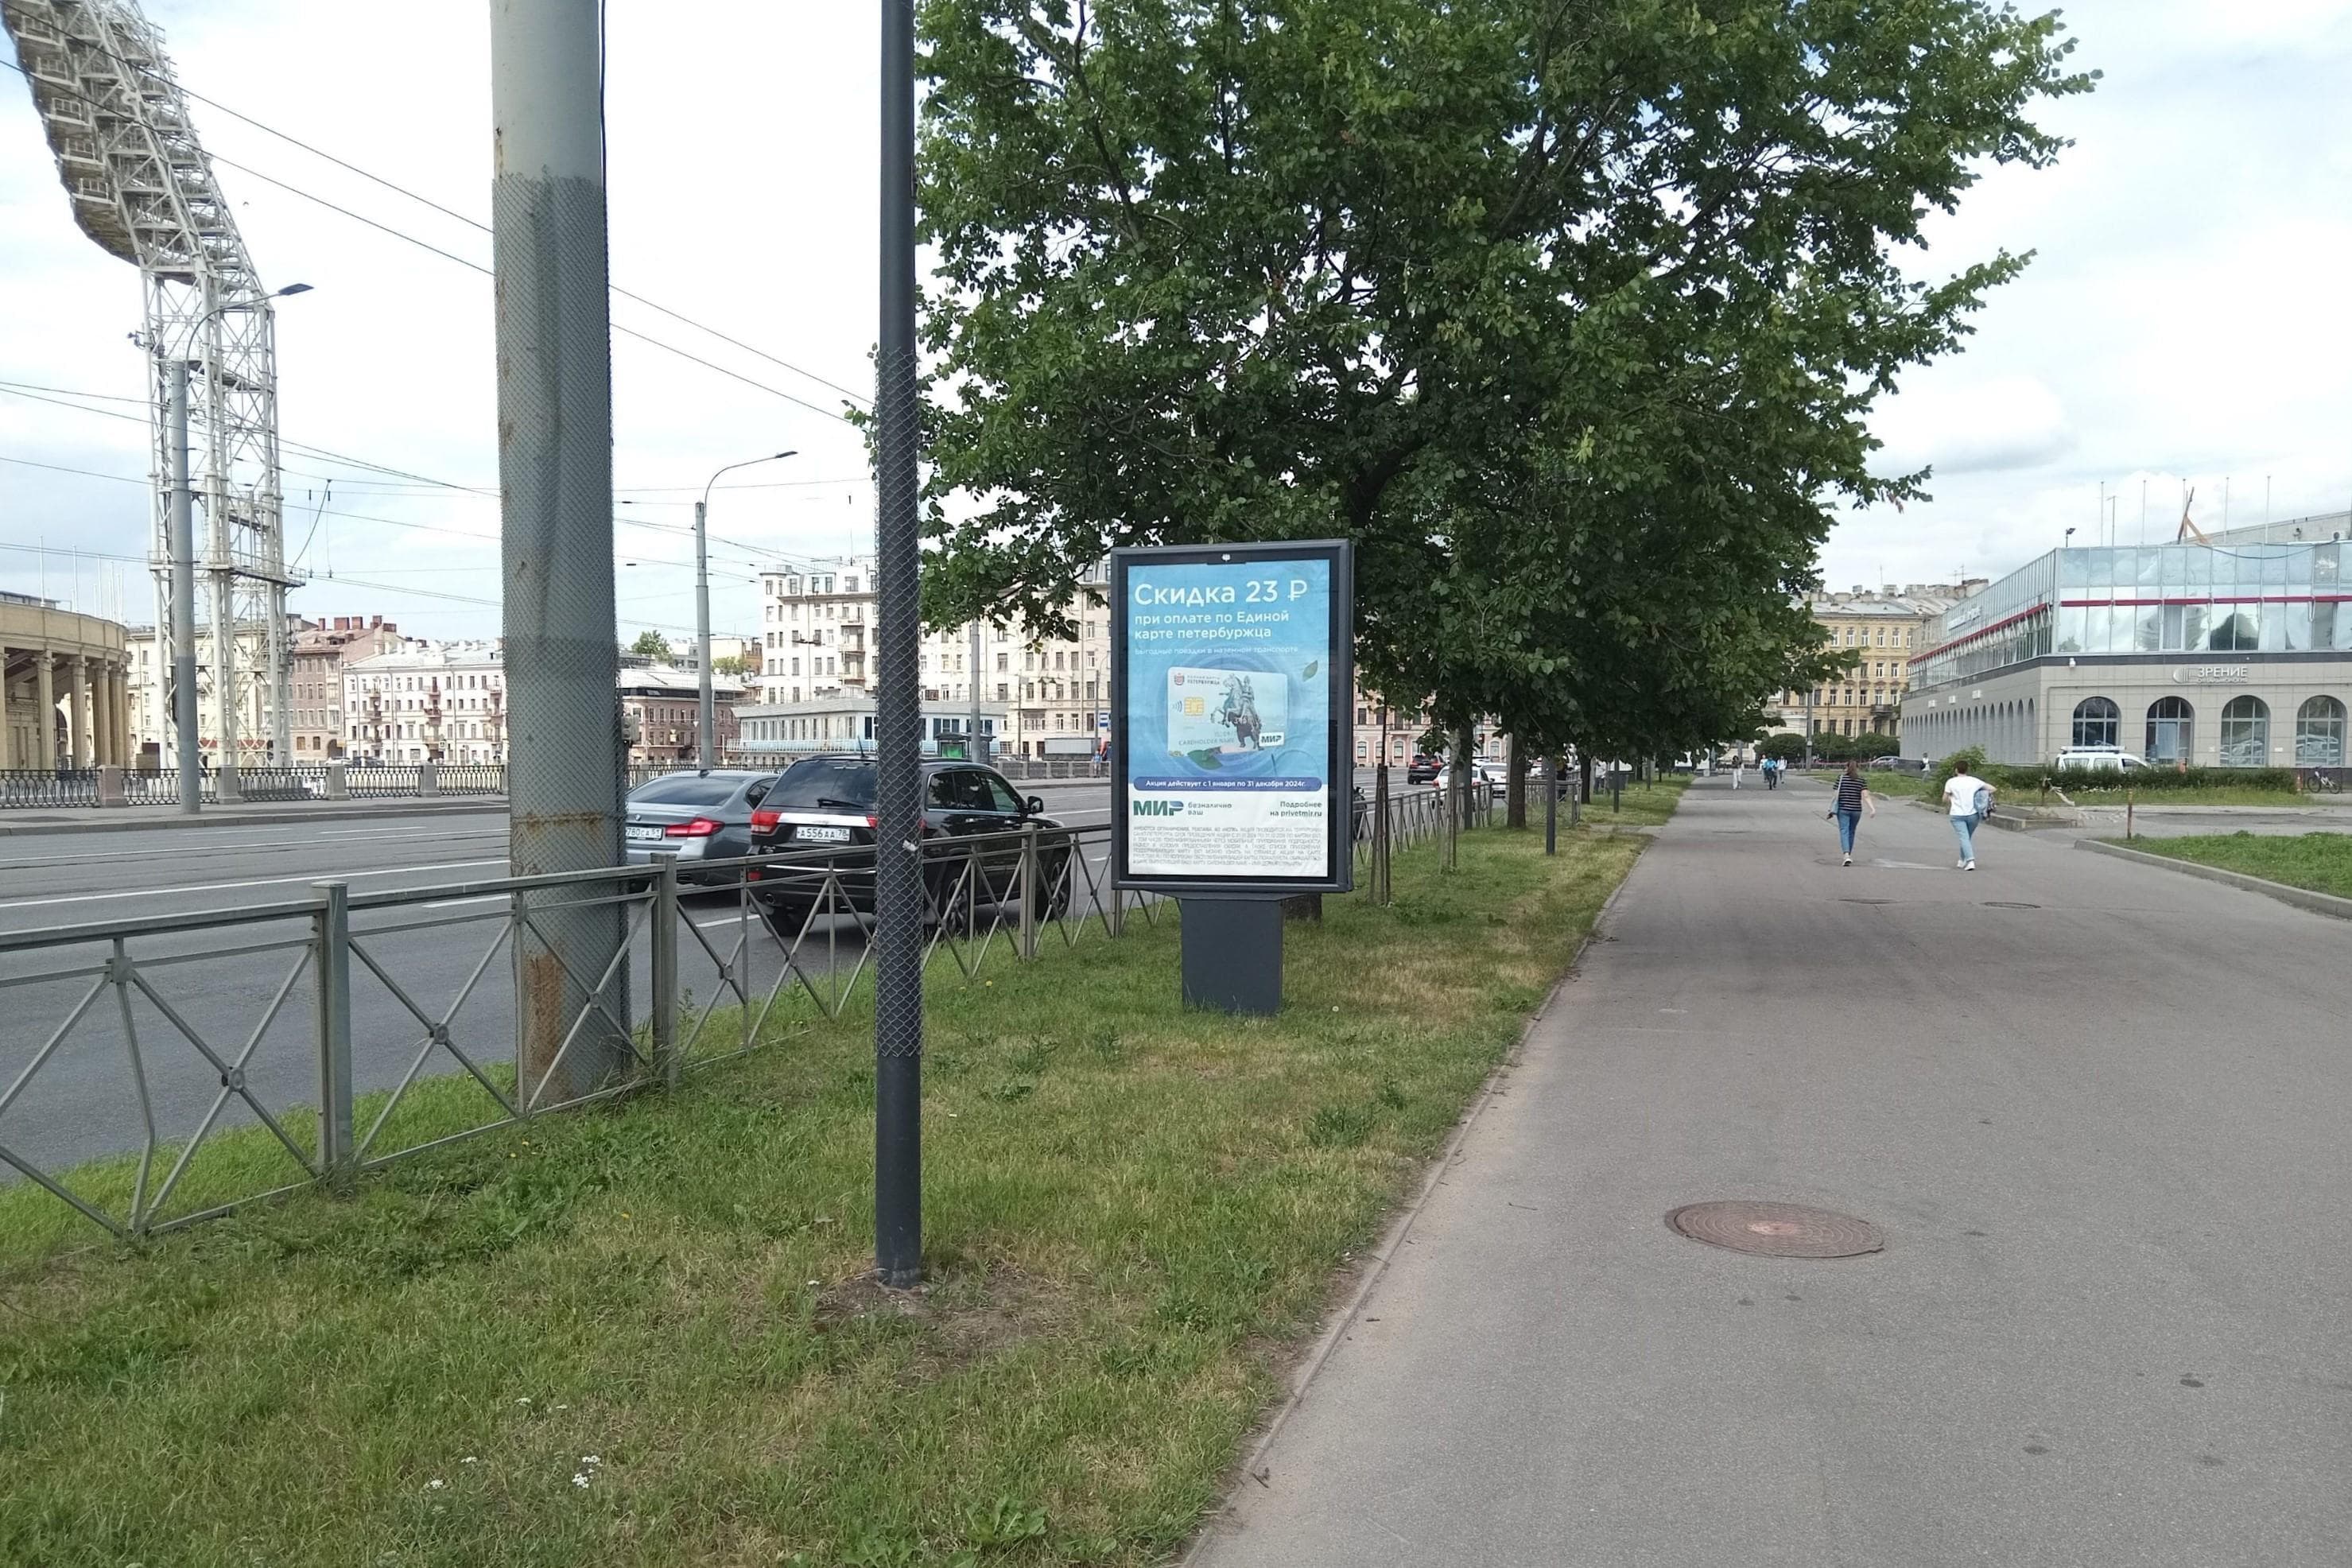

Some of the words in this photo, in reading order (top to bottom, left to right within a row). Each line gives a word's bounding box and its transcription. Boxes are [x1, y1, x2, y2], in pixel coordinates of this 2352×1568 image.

[1135, 584, 1236, 607] Скидка
[1245, 580, 1278, 603] 23
[1135, 615, 1160, 627] при
[1164, 613, 1212, 624] оплате
[1216, 613, 1232, 623] по
[1237, 610, 1290, 624] Единой
[1135, 627, 1174, 642] карте
[1178, 627, 1271, 641] петербуржца
[2197, 666, 2248, 677] ЗРЕНИЕ
[1260, 735, 1282, 744] МИР
[1168, 780, 1201, 789] действует
[1133, 801, 1184, 816] МИР
[1279, 801, 1322, 809] Подробнее
